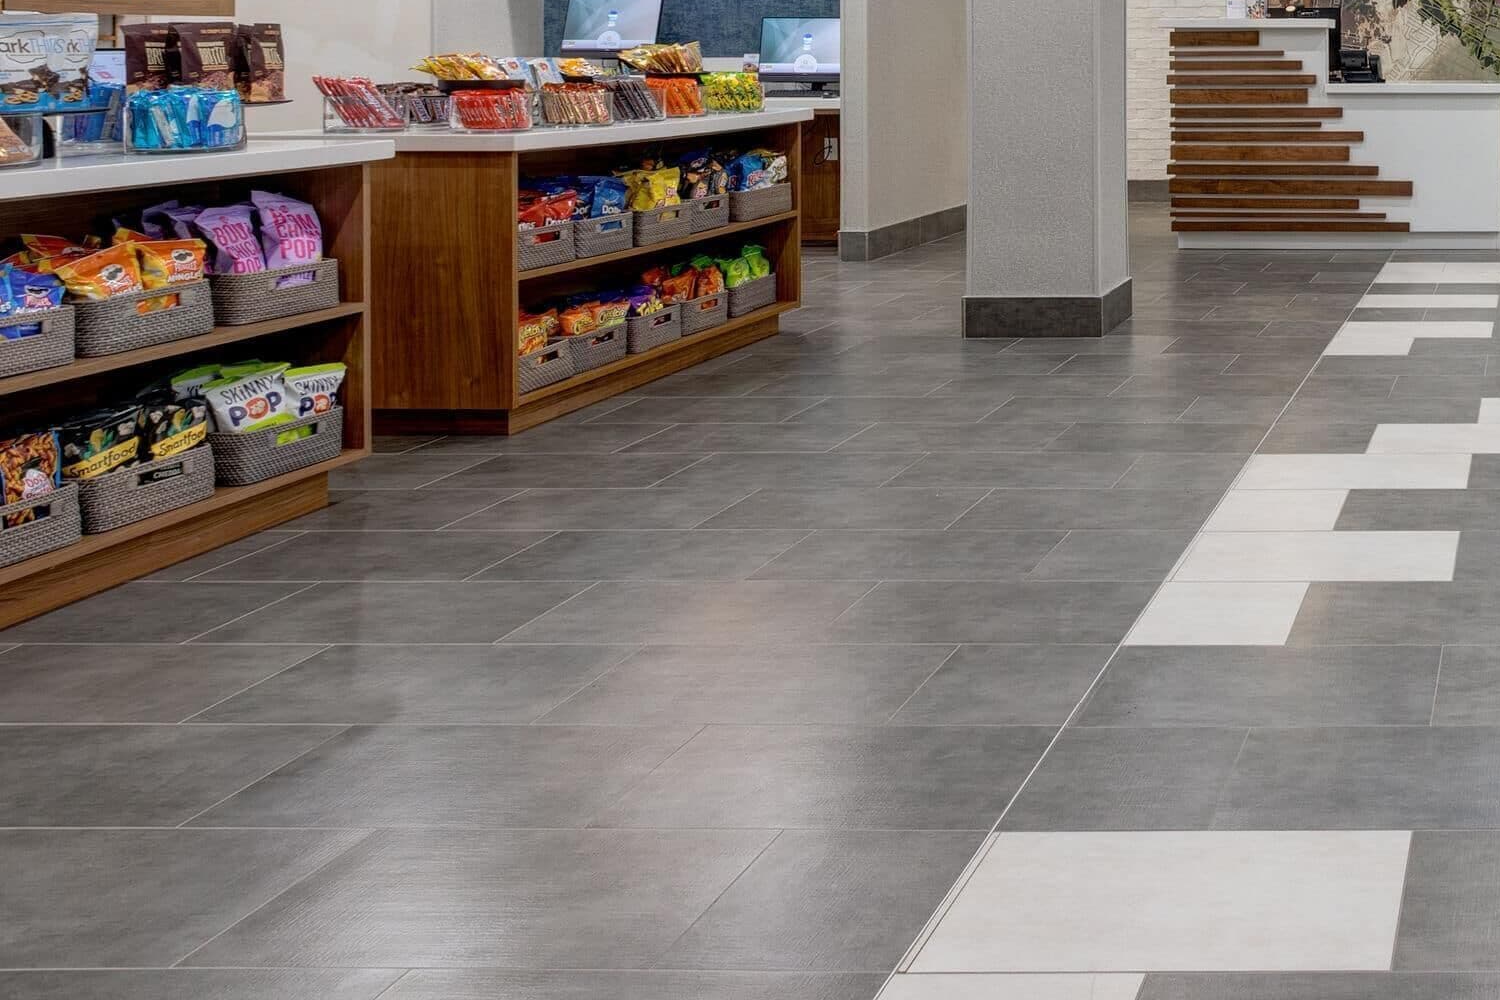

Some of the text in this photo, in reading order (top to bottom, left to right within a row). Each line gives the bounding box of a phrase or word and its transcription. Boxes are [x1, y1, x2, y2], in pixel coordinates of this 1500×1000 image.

[279, 238, 317, 259] POP
[228, 391, 282, 427] POP
[69, 441, 138, 478] Smartfood
